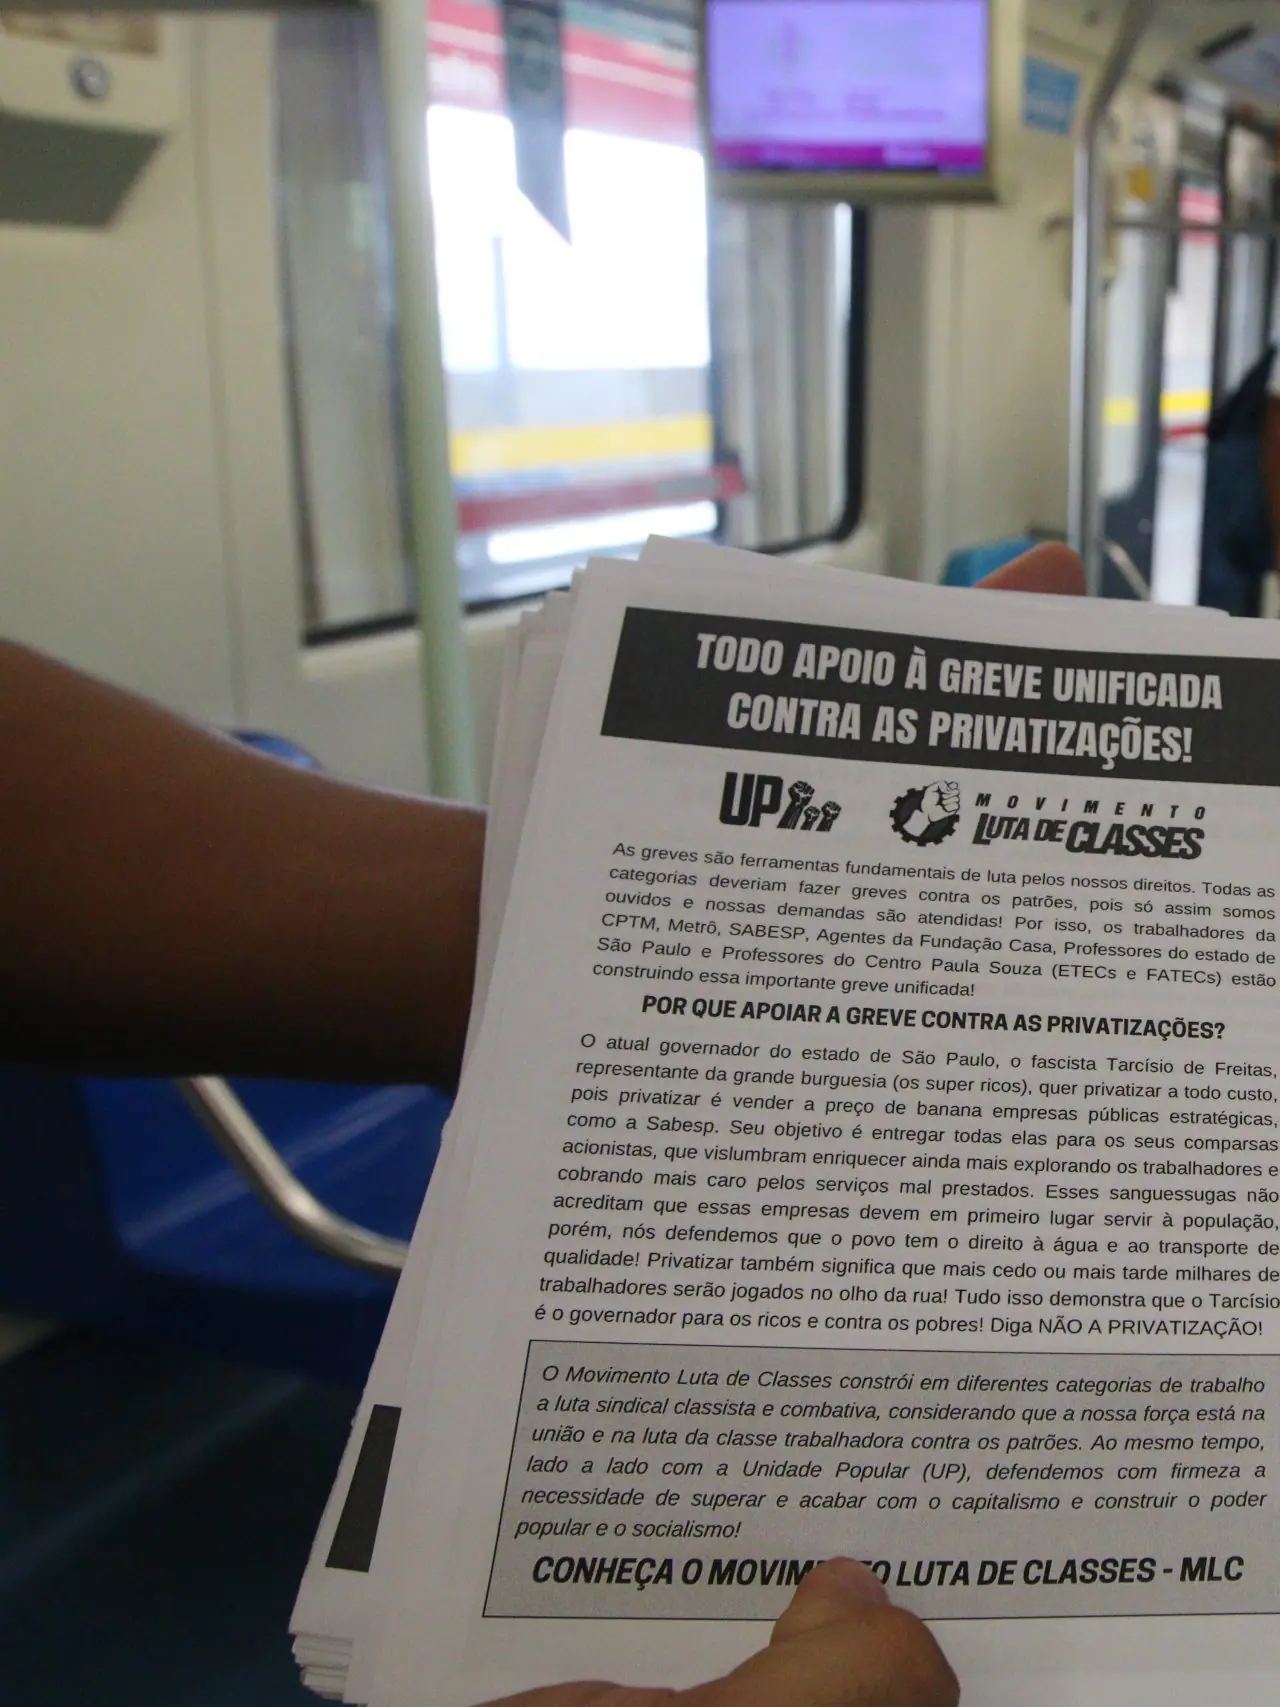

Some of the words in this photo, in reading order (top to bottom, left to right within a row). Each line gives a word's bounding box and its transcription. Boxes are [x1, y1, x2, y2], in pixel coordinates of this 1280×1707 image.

[697, 633, 784, 676] TODO
[792, 642, 896, 687] APOIO
[904, 645, 927, 691] À
[939, 657, 1043, 700] GREVE
[1052, 667, 1223, 710] UNIFICADA
[726, 691, 861, 741] CONTRA
[871, 705, 919, 745] AS
[928, 710, 1193, 771] PRIVATIZAÇÕES!
[719, 772, 784, 828] UP
[975, 793, 1206, 820] MOVIMENTO
[972, 812, 1031, 846] LUTA
[1034, 818, 1067, 842] DE
[1065, 820, 1206, 860] CLASSES
[612, 843, 635, 857] As
[641, 847, 698, 863] greves
[704, 851, 734, 865] são
[740, 853, 840, 873] ferramentas
[845, 860, 955, 880] fundamentais
[961, 868, 981, 882] de
[987, 869, 1016, 884] luta
[1021, 873, 1065, 887] pelos
[1071, 877, 1128, 890] nossos
[1133, 878, 1195, 893] direitos.
[1201, 882, 1251, 897] Todas
[1257, 887, 1275, 898] as
[605, 891, 672, 907] ouvidos
[683, 898, 694, 909] e
[705, 900, 766, 914] nossas
[777, 902, 865, 920] demandas
[876, 908, 906, 923] são
[918, 912, 1002, 928] atendidas!
[1015, 916, 1044, 930] Por
[1054, 918, 1091, 934] isso,
[1103, 923, 1123, 934] os
[1134, 922, 1244, 940] trabalhadores
[1255, 929, 1276, 942] da
[593, 964, 694, 982] construindo
[699, 972, 740, 984] essa
[745, 971, 836, 990] importante
[841, 980, 889, 994] greve
[894, 980, 975, 996] unificada!
[597, 937, 632, 953] São
[642, 940, 691, 957] Paulo
[701, 947, 712, 959] e
[722, 946, 824, 965] Professores
[833, 952, 855, 967] do
[865, 954, 922, 970] Centro
[931, 958, 980, 973] Paula
[989, 961, 1043, 976] Souza
[1052, 964, 1117, 980] (ETECs
[1126, 969, 1136, 980] e
[1147, 968, 1222, 987] FATECs)
[1231, 973, 1276, 987] estão
[642, 994, 688, 1016] POR
[692, 998, 737, 1019] QUE
[739, 1001, 822, 1023] APOIAR
[825, 1005, 840, 1024] A
[846, 1006, 917, 1027] GREVE
[921, 1010, 1008, 1031] CONTRA
[1012, 1014, 1042, 1032] AS
[1047, 1015, 1226, 1042] PRIVATIZAÇÕES?
[580, 1033, 596, 1048] O
[606, 1036, 650, 1051] atual
[659, 1041, 760, 1057] governador
[769, 1044, 792, 1059] do
[801, 1047, 860, 1062] estado
[870, 1048, 891, 1063] de
[902, 1050, 936, 1065] São
[946, 1052, 999, 1069] Paulo,
[1010, 1057, 1021, 1068] o
[1031, 1054, 1097, 1071] fascista
[1106, 1057, 1174, 1074] Tarcísio
[1184, 1060, 1205, 1075] de
[1215, 1062, 1277, 1079] Freitas,
[571, 1086, 608, 1104] pois
[618, 1088, 702, 1106] privatizar
[711, 1092, 722, 1107] é
[733, 1094, 794, 1110] vender
[804, 1099, 815, 1111] a
[825, 1100, 874, 1117] preço
[884, 1100, 907, 1115] de
[917, 1100, 983, 1118] banana
[992, 1106, 1078, 1123] empresas
[1088, 1106, 1159, 1125] públicas
[1169, 1110, 1278, 1129] estratégicas,
[562, 1139, 657, 1160] acionistas,
[664, 1146, 698, 1163] que
[704, 1145, 807, 1164] vislumbram
[812, 1150, 907, 1169] enriquecer
[912, 1153, 961, 1169] ainda
[966, 1155, 1008, 1171] mais
[1014, 1157, 1111, 1176] explorando
[1117, 1162, 1138, 1174] os
[1143, 1160, 1263, 1177] trabalhadores
[1268, 1165, 1279, 1177] e
[553, 1194, 643, 1211] acreditam
[653, 1200, 688, 1216] que
[697, 1202, 751, 1216] essas
[761, 1204, 850, 1221] empresas
[859, 1204, 920, 1221] devem
[929, 1209, 957, 1222] em
[967, 1208, 1040, 1226] primeiro
[1050, 1210, 1095, 1229] lugar
[1104, 1212, 1153, 1227] servir
[1162, 1212, 1174, 1227] à
[1183, 1213, 1279, 1232] população,
[544, 1248, 640, 1268] qualidade!
[647, 1252, 734, 1270] Privatizar
[740, 1255, 814, 1272] também
[821, 1257, 896, 1277] significa
[902, 1263, 936, 1279] que
[943, 1261, 986, 1277] mais
[992, 1262, 1037, 1278] cedo
[1043, 1266, 1066, 1279] ou
[1073, 1264, 1116, 1280] mais
[1122, 1265, 1168, 1280] tarde
[1176, 1265, 1251, 1282] milhares
[1258, 1266, 1280, 1282] de
[542, 1365, 560, 1382] O
[565, 1366, 671, 1385] Movimento
[676, 1369, 719, 1386] Luta
[726, 1369, 751, 1387] de
[757, 1370, 833, 1389] Classes
[839, 1373, 915, 1390] constrói
[920, 1377, 950, 1391] em
[956, 1374, 1049, 1392] diferentes
[1056, 1376, 1152, 1397] categorias
[1159, 1376, 1183, 1393] de
[1190, 1376, 1265, 1393] trabalho
[532, 1424, 585, 1443] união
[592, 1429, 605, 1443] e
[610, 1430, 636, 1444] na
[642, 1426, 678, 1445] luta
[684, 1428, 710, 1445] da
[716, 1429, 778, 1447] classe
[784, 1430, 904, 1449] trabalhadora
[911, 1434, 970, 1450] contra
[977, 1437, 1000, 1450] os
[1005, 1434, 1082, 1454] patrões.
[1090, 1434, 1117, 1451] Ao
[1124, 1437, 1194, 1451] mesmo
[1201, 1435, 1264, 1454] tempo,
[532, 1555, 674, 1590] CONHEÇA
[681, 1558, 704, 1586] O
[708, 1558, 891, 1586] MOVIMO
[896, 1559, 971, 1587] LUTA
[977, 1559, 1017, 1586] DE
[1022, 1557, 1157, 1585] CLASSES
[1180, 1555, 1245, 1583] MLC
